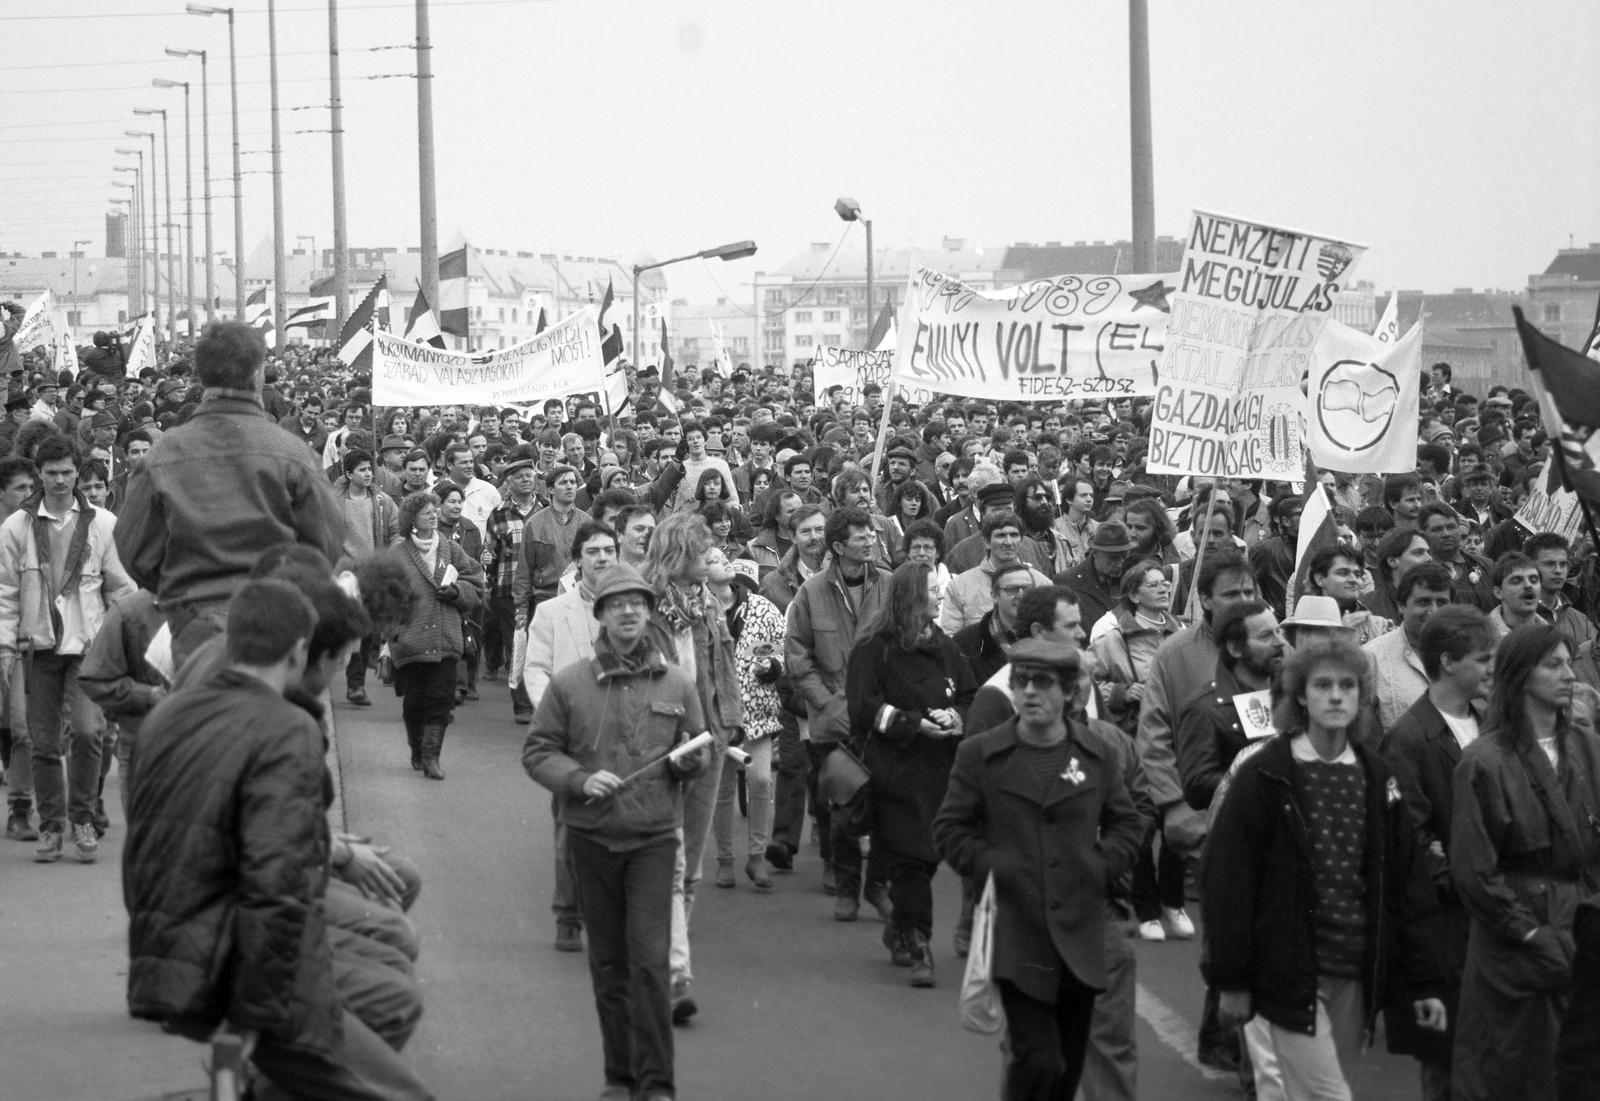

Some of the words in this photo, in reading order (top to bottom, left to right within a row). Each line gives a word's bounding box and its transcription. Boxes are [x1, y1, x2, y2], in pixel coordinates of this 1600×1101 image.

[1189, 215, 1312, 272] NEMZETI
[1180, 257, 1341, 314] MEGÚJULÁS
[383, 360, 428, 384] SZABAD
[813, 343, 826, 368] A
[996, 320, 1084, 381] VOLT
[1155, 384, 1265, 434] GAZDASÁGI
[1149, 427, 1264, 476] BIZTONSÁG
